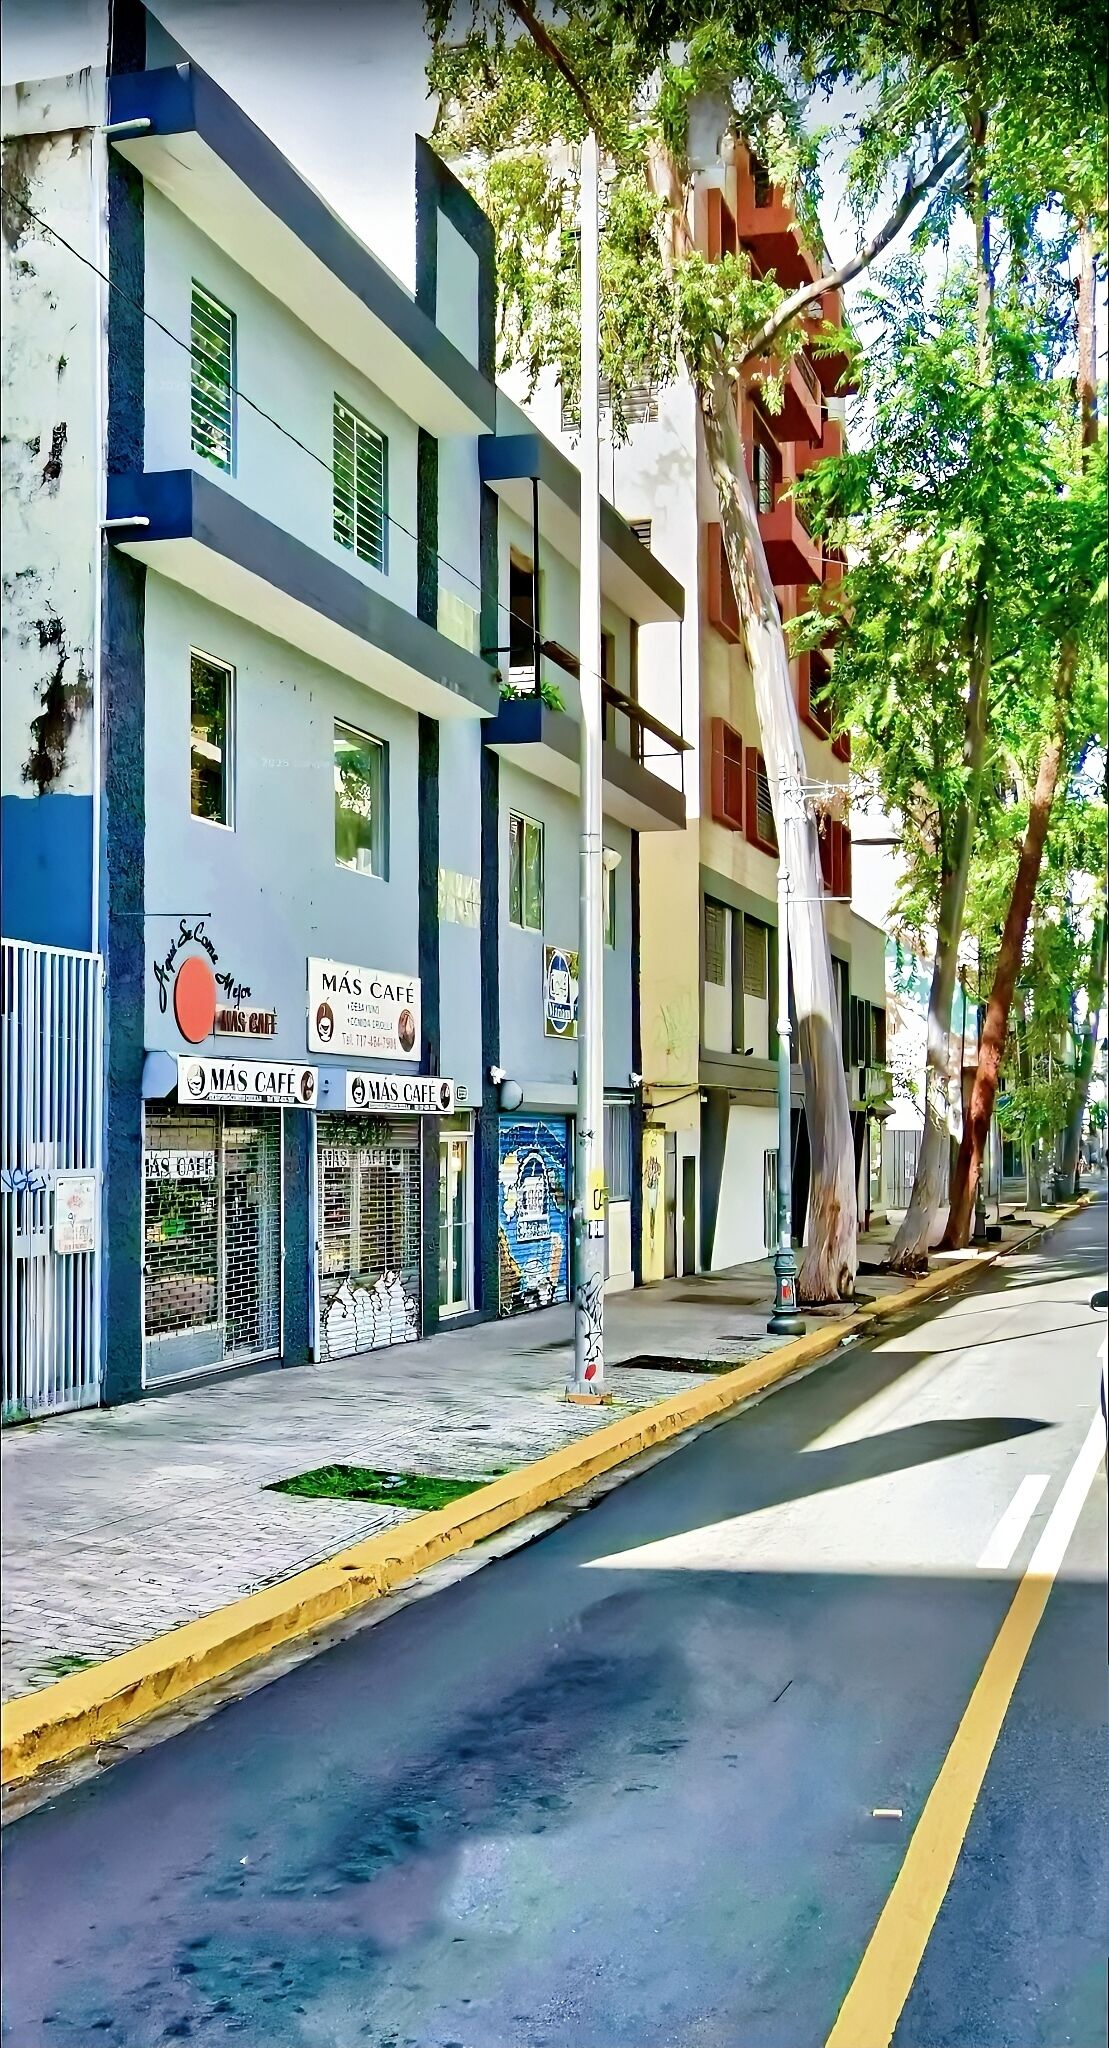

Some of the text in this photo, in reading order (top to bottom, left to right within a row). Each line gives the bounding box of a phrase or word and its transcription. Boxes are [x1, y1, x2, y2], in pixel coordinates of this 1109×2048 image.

[178, 919, 193, 948] Se
[194, 922, 219, 965] Come
[215, 973, 252, 1010] Mejor
[322, 970, 415, 1004] MÁS CAFÉ
[210, 1063, 296, 1095] MÁS CAFÉ
[368, 1077, 399, 1101] MÁS
[403, 1080, 437, 1103] CAFÉ
